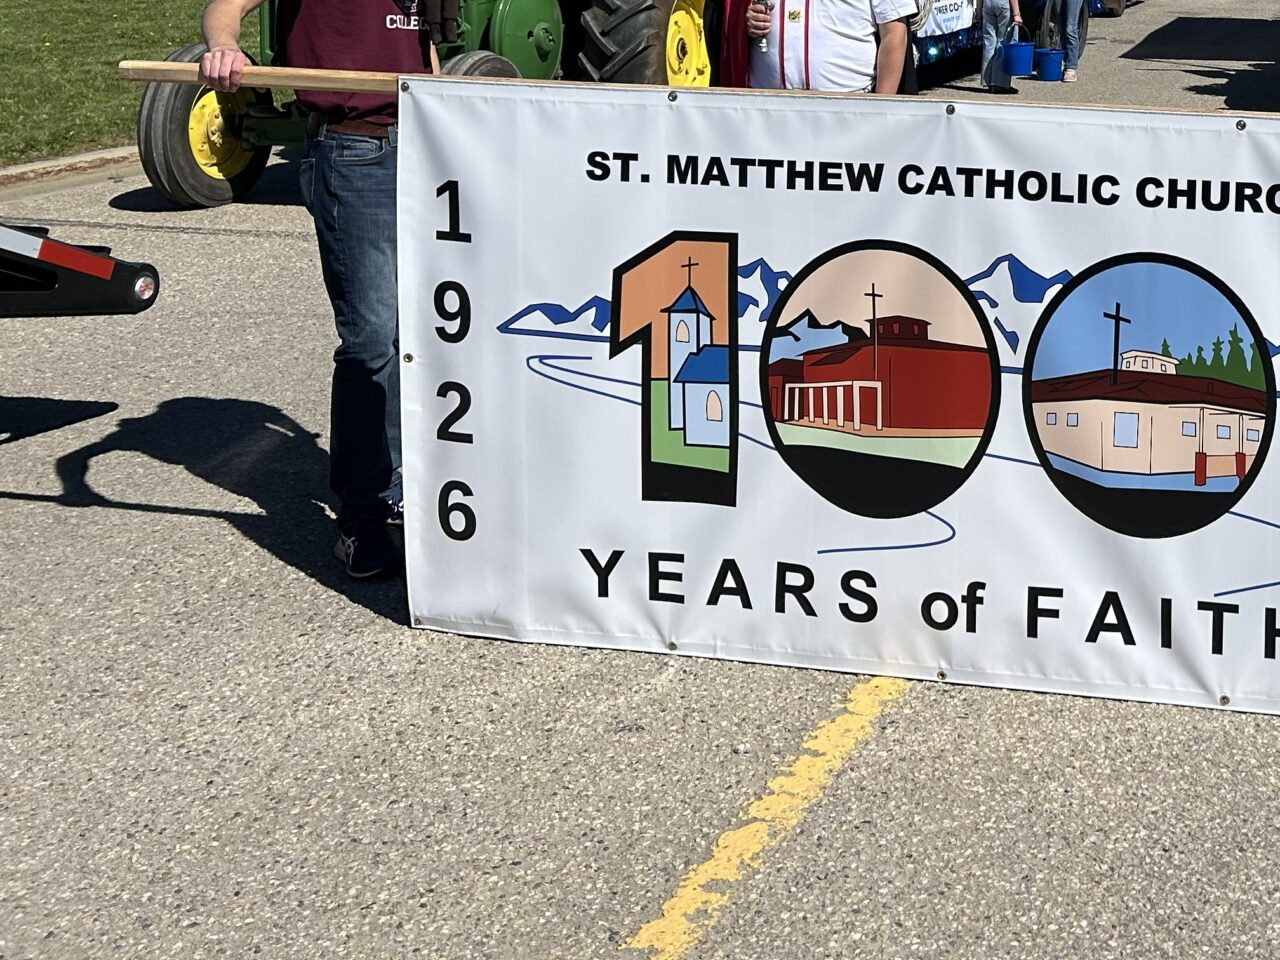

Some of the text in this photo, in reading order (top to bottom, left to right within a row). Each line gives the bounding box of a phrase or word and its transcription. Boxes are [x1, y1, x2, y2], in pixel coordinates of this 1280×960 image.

[585, 150, 651, 184] ST.
[666, 154, 885, 193] MATTHEW
[897, 163, 1121, 207] CATHOLIC
[578, 547, 880, 624] YEARS
[920, 581, 985, 635] of
